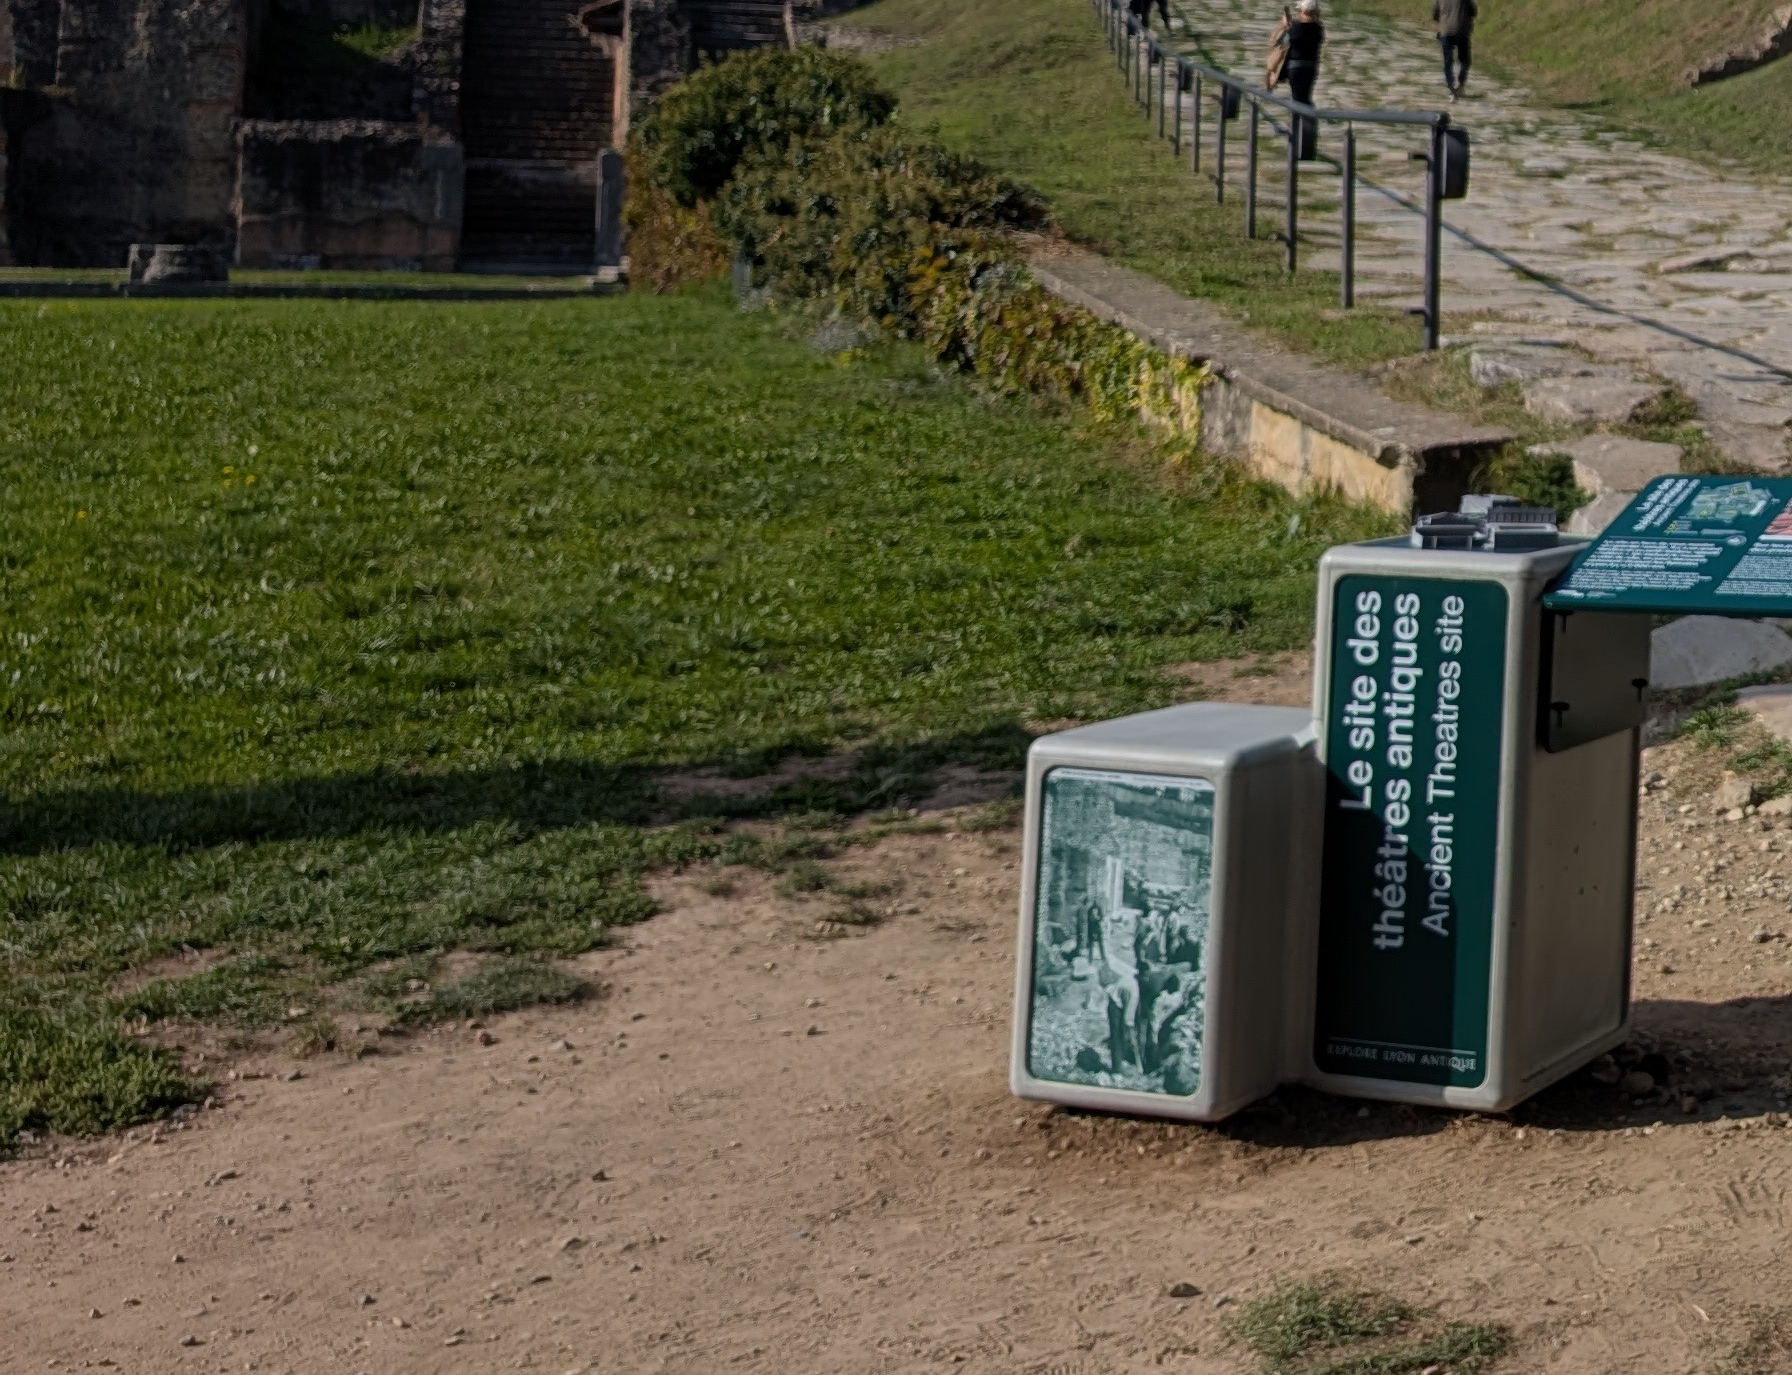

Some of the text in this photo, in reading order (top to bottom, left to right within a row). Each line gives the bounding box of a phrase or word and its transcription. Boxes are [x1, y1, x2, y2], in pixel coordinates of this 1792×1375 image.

[1339, 590, 1382, 810] Le site des
[1372, 592, 1424, 950] théâtres antiques
[1421, 595, 1465, 938] Ancient Theatres site
